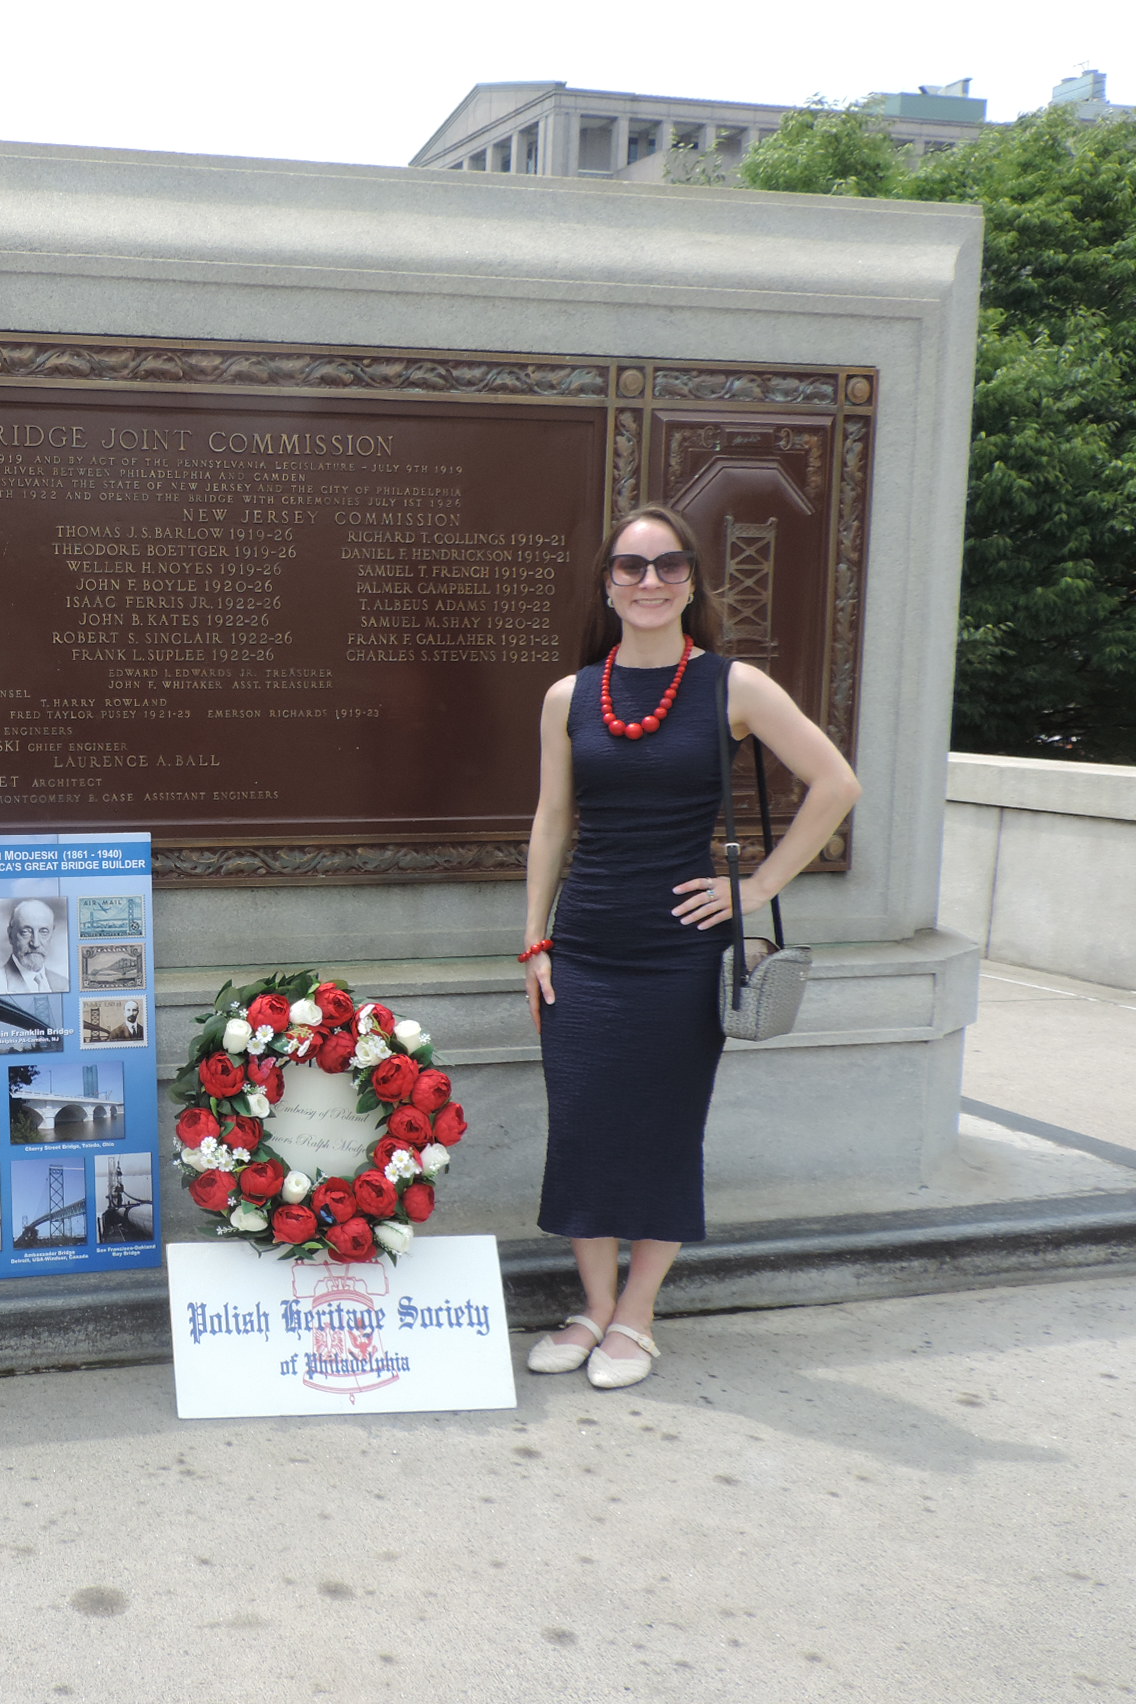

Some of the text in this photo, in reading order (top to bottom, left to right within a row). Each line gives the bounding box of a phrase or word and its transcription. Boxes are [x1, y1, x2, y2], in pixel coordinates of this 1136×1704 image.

[101, 427, 192, 450] JOINT
[208, 431, 393, 456] COMMISSION
[71, 479, 95, 488] THE
[103, 480, 140, 489] STATE
[147, 481, 162, 490] OF
[171, 481, 198, 491] NEW
[205, 482, 251, 491] JERSEY
[257, 483, 282, 493] AND
[290, 484, 313, 493] THE
[320, 485, 348, 494] CITY
[355, 485, 369, 494] OF
[376, 486, 461, 496] PHILADELPHIA
[182, 508, 460, 526] NEW JERSEY COMMISSION
[347, 530, 415, 543] RICHARD
[434, 532, 505, 545] COLLINGS
[510, 533, 565, 546] 1919-21
[51, 542, 296, 558] THEODORE BOETTGER 1919-26
[340, 547, 395, 559] DANIEL
[411, 548, 512, 561] HENDRICKSON
[516, 550, 570, 562] 1919-21
[357, 564, 414, 577] SAMUEL
[431, 566, 489, 578] FRENCH
[494, 567, 555, 579] 1919-20
[75, 578, 119, 591] JOHN
[142, 579, 197, 592] BOYLE
[203, 579, 272, 593] 1920-26
[356, 581, 555, 595] PALMER CAMPBELL 1919-20
[65, 595, 116, 608] ISAAC
[124, 596, 183, 609] FERRIS
[217, 596, 281, 610] 1922-26
[51, 631, 119, 644] ROBERT
[144, 632, 223, 644] SINCLAIR
[230, 632, 293, 645] 1922-26
[346, 632, 397, 645] FRANK
[416, 632, 496, 646] GALLAHER
[500, 634, 559, 646] 1921-22
[9, 710, 40, 719] FRED
[46, 710, 94, 719] TAYLOR
[100, 710, 136, 719] PUSEY
[207, 708, 379, 718] EMERSON RICHARDS 1919-23
[3, 726, 72, 735] ENGINEERS
[27, 742, 63, 752] CHIEF
[68, 742, 127, 751] ENGINEER
[53, 755, 148, 768] LAURENCE
[175, 754, 220, 766] BALL
[31, 777, 102, 787] ARCHITECT
[5, 851, 58, 861] MODJESKI
[63, 850, 88, 861] (1861
[97, 850, 122, 859] 1940)
[24, 862, 58, 871] GREAT
[61, 861, 99, 870] BRIDGE
[102, 860, 145, 869] BUILDER
[47, 1028, 74, 1036] Bridge
[274, 1103, 370, 1122] Embassy of Poland
[296, 1133, 330, 1152] Ralph
[187, 1296, 490, 1344] Polish Heritage Society
[280, 1352, 410, 1379] of Philadelphia
